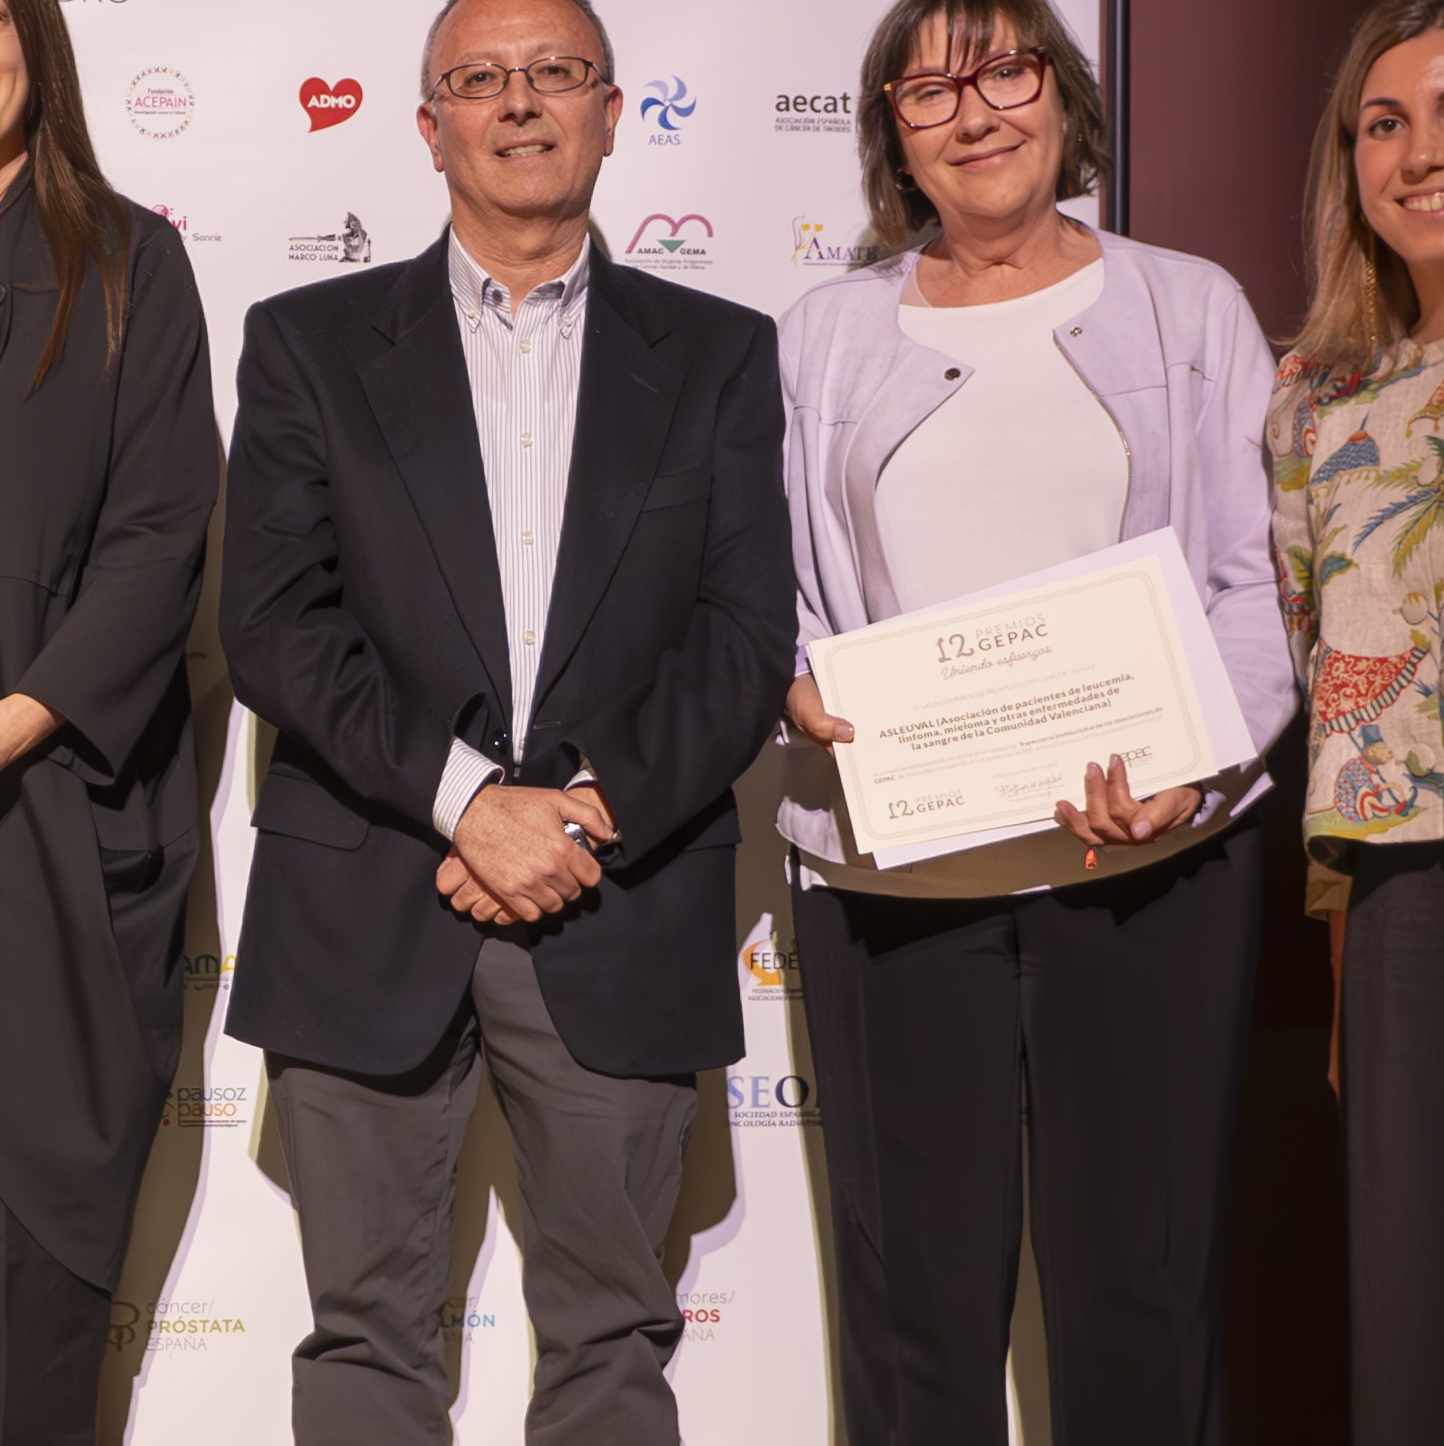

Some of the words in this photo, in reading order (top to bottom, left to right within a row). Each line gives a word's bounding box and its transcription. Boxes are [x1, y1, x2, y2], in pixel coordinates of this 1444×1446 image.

[134, 95, 188, 109] ACEPAIN
[306, 93, 357, 110] ADMO
[774, 91, 852, 115] aecat
[647, 133, 681, 146] AEAS
[288, 252, 318, 262] MARCO
[679, 247, 707, 256] GEMA
[975, 613, 1047, 639] PREMIOS
[977, 623, 1049, 652] GEPAC
[935, 634, 976, 664] 12
[941, 661, 995, 681] Uniendo
[996, 645, 1053, 668] esfuerzos
[879, 719, 934, 739] ASLEUVAL
[935, 705, 999, 729] (Asociación
[999, 702, 1013, 713] de
[1014, 692, 1067, 712] pacientes
[1066, 686, 1082, 696] de
[898, 728, 943, 745] linfoma,
[944, 718, 991, 736] mieloma
[991, 718, 999, 728] y
[999, 710, 1029, 724] otras
[1028, 693, 1106, 717] enfermedades
[1106, 685, 1121, 696] de
[911, 742, 920, 751] la
[920, 733, 960, 751] sangre
[960, 730, 974, 741] de
[974, 728, 986, 738] la
[985, 712, 1048, 736] Comunidad
[1048, 699, 1113, 723] Valenciana)
[888, 800, 915, 821] 12
[916, 795, 966, 814] GEPAC
[178, 1086, 247, 1103] pausoz
[178, 1102, 237, 1122] pauso
[145, 1298, 215, 1316] cáncer/
[147, 1316, 246, 1334] PRÓSTATA
[146, 1335, 208, 1353] ESPAÑA
